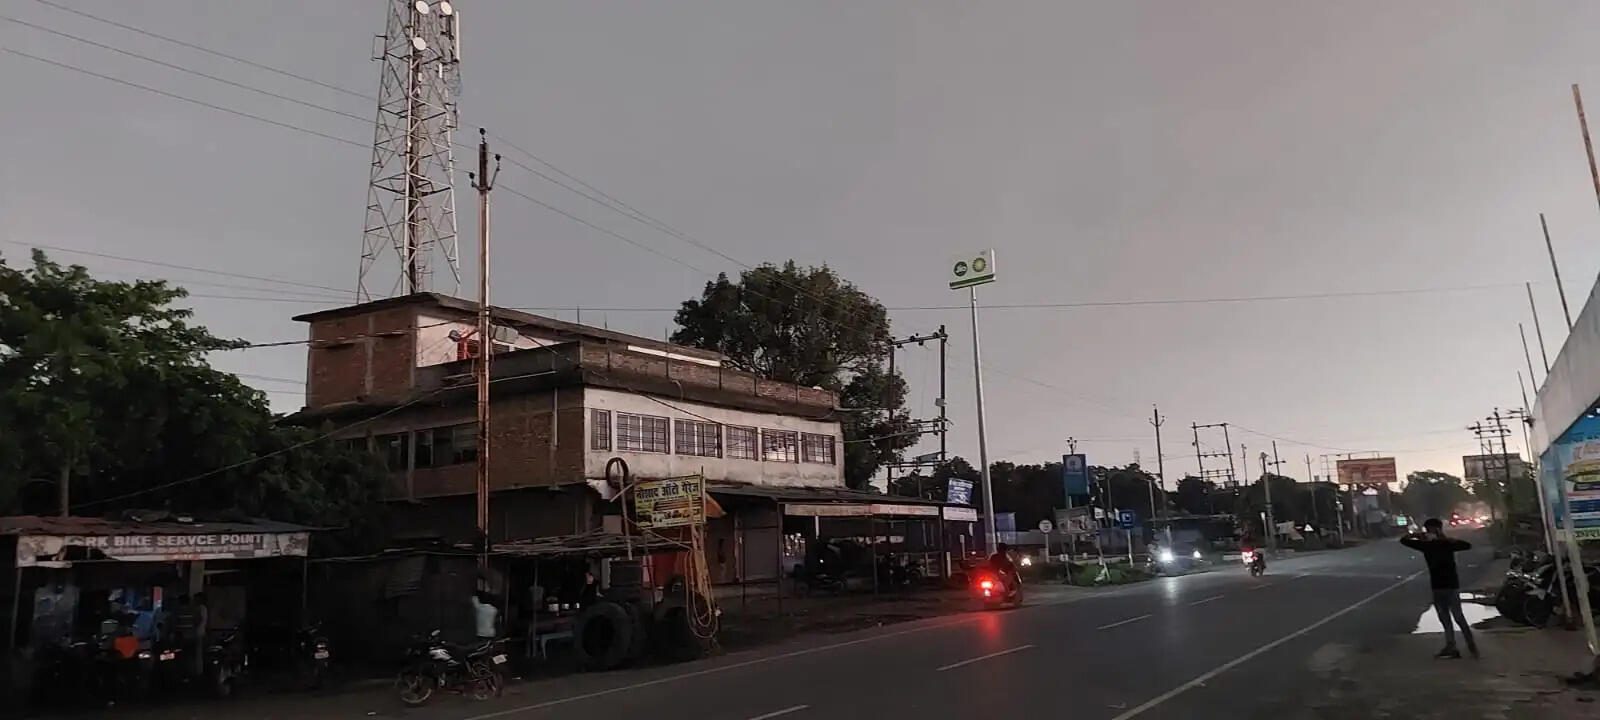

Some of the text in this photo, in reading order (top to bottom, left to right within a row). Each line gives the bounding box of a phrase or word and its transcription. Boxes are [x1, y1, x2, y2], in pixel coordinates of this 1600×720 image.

[113, 535, 152, 547] BIKE
[156, 535, 216, 547] SERVCE
[220, 533, 262, 546] POINT
